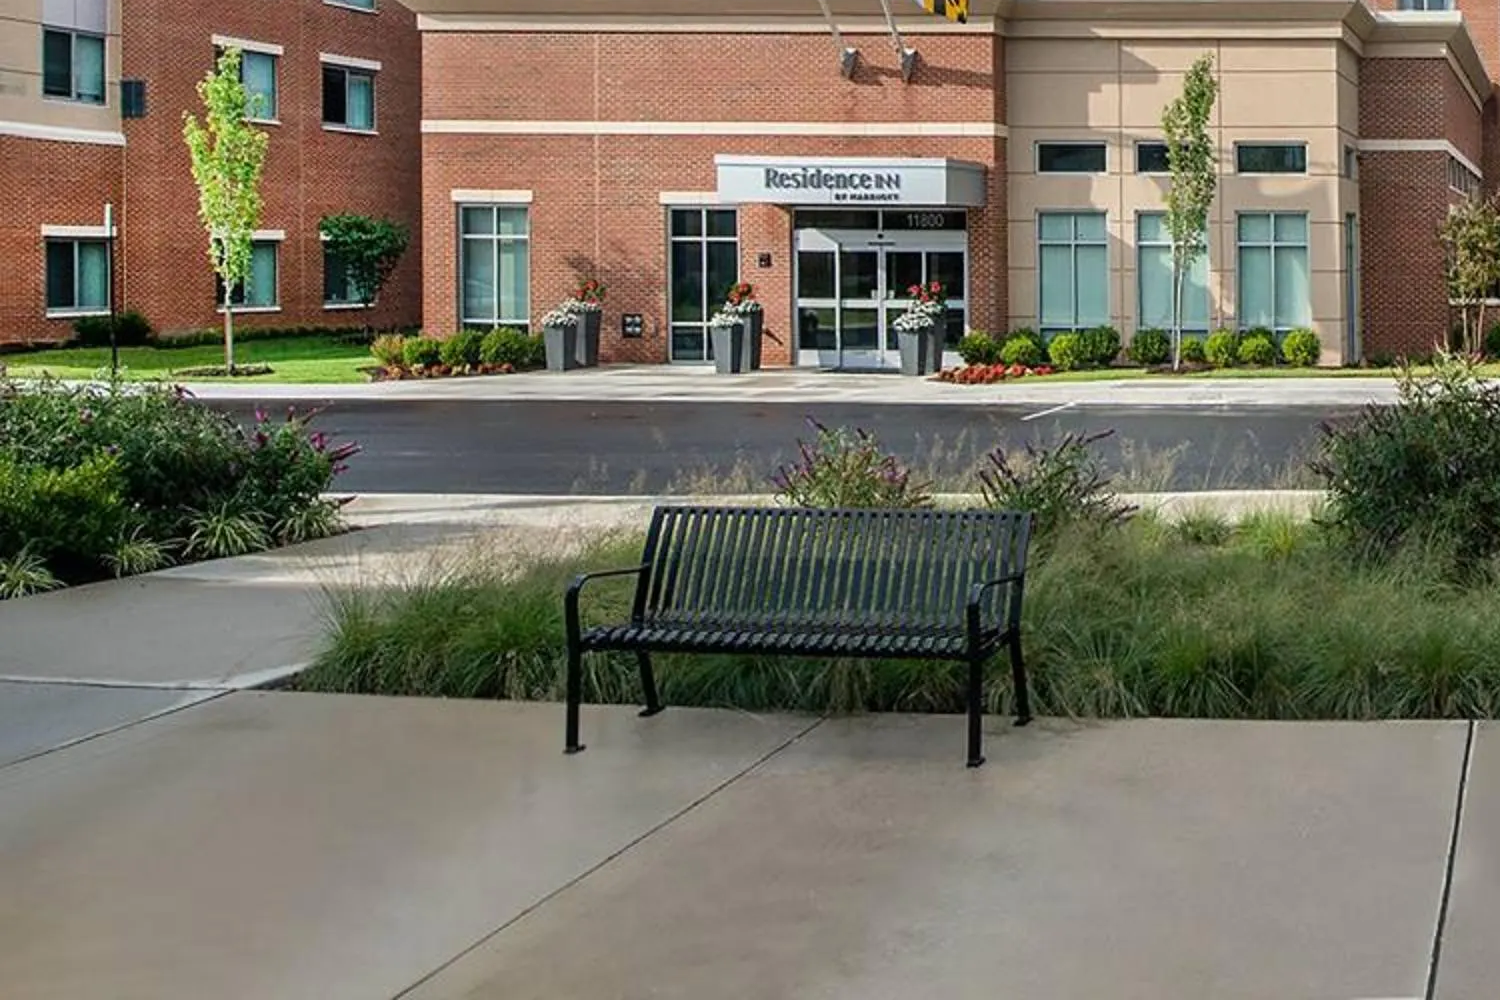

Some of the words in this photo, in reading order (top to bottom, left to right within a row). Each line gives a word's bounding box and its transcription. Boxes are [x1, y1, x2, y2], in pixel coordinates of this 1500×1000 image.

[764, 167, 872, 190] Residence
[874, 173, 901, 190] INN
[907, 213, 945, 228] 11800
